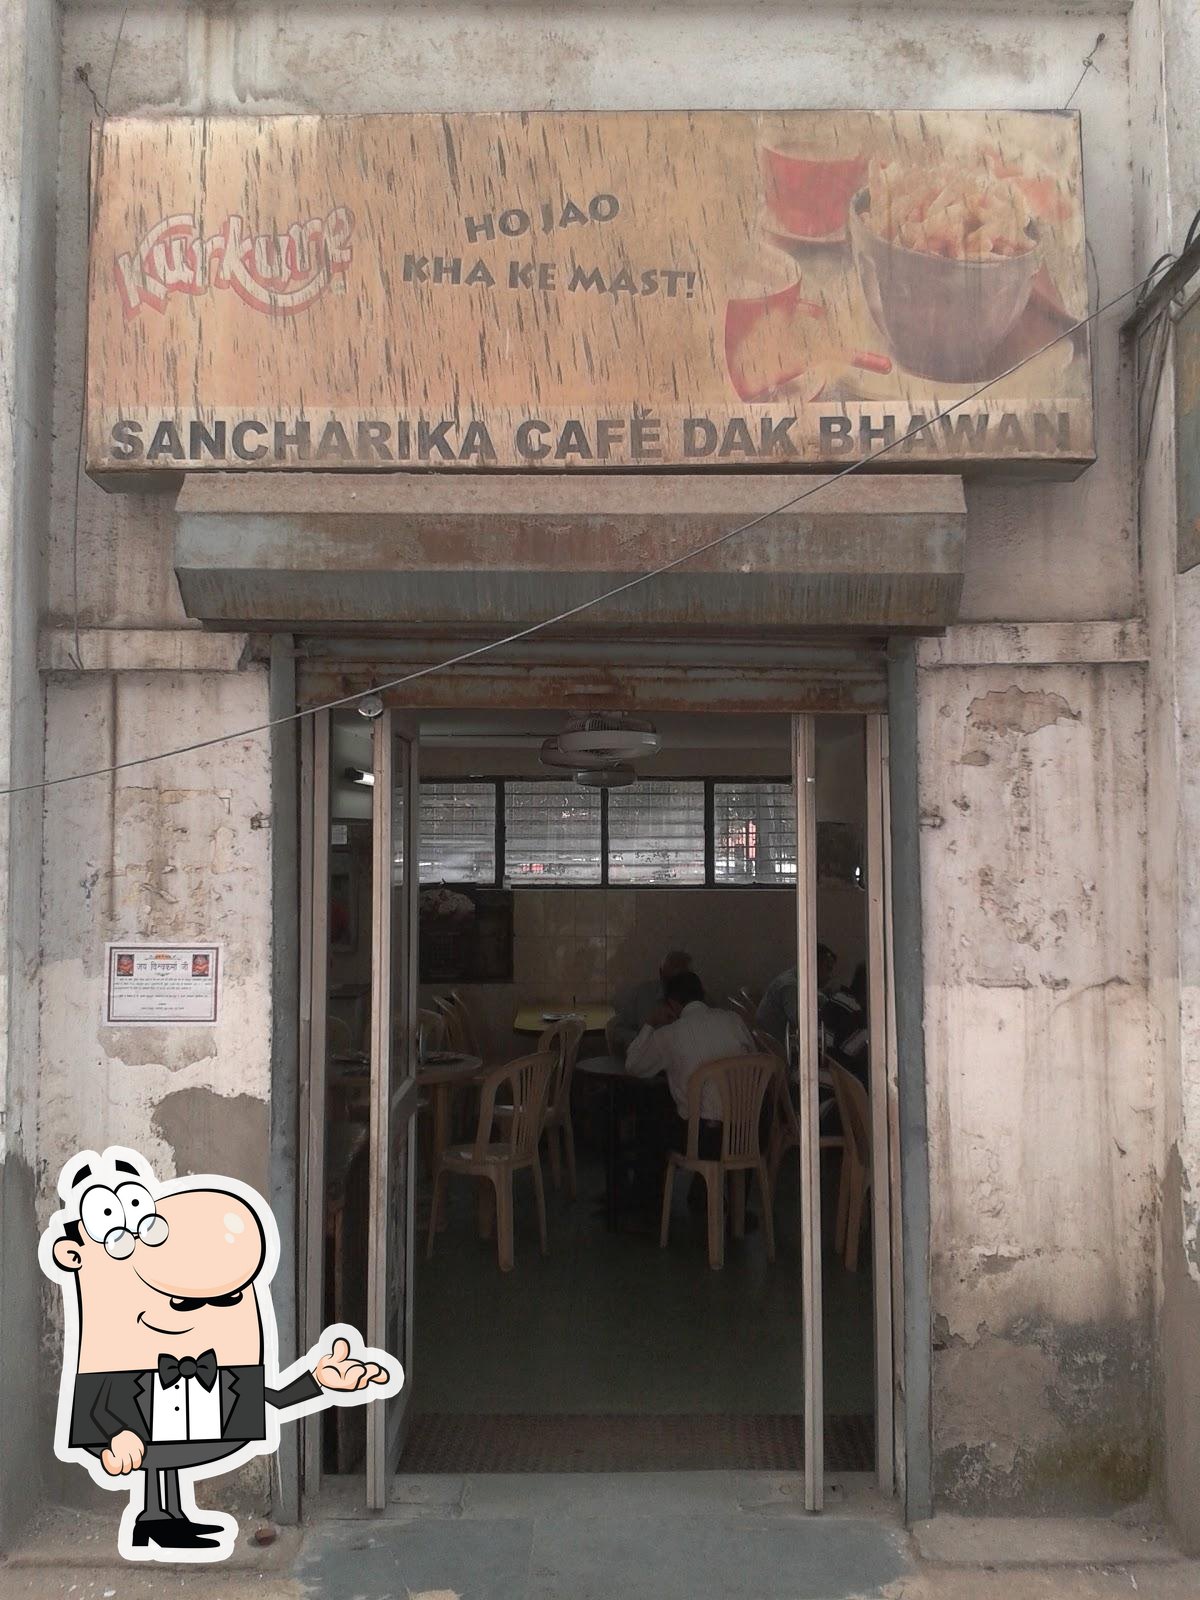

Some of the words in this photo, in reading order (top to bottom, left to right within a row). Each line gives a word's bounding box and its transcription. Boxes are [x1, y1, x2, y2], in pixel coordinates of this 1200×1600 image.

[464, 208, 531, 243] HO
[402, 253, 496, 288] KHA
[508, 260, 557, 291] KE
[567, 264, 696, 300] MAST!
[110, 419, 498, 462] SANCHARIKA
[683, 416, 800, 459] DAK
[818, 411, 1071, 456] BHAWAN
